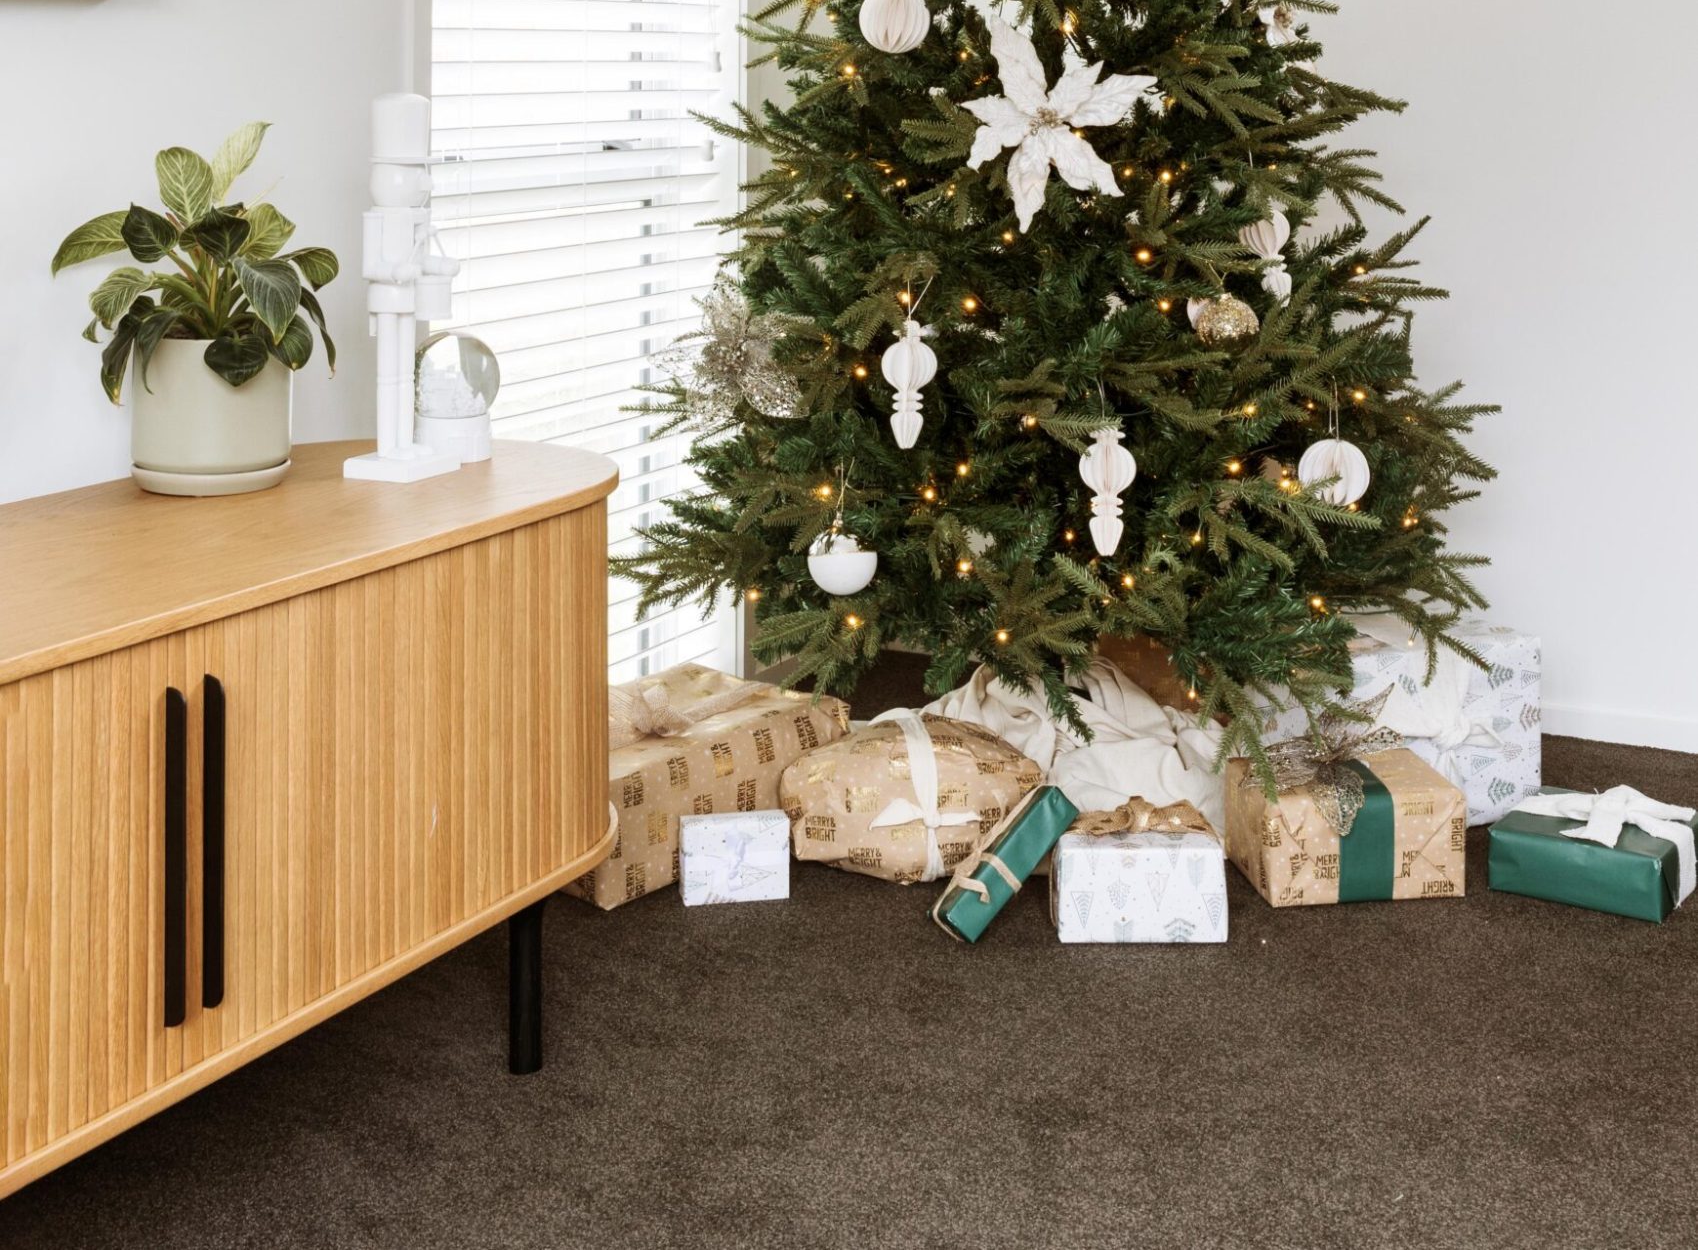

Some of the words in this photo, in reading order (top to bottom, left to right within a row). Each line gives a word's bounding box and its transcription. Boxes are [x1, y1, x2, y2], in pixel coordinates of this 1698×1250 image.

[760, 727, 776, 763] BRIGHT
[801, 715, 819, 748] BRIGHT
[667, 758, 679, 788] ERRY&
[624, 775, 633, 809] MERR
[805, 816, 836, 828] MERRY&
[980, 805, 1010, 821] MERR&
[805, 827, 836, 843] BRIGHT
[1451, 817, 1464, 854] BRIGHT
[1315, 854, 1340, 867] MERR
